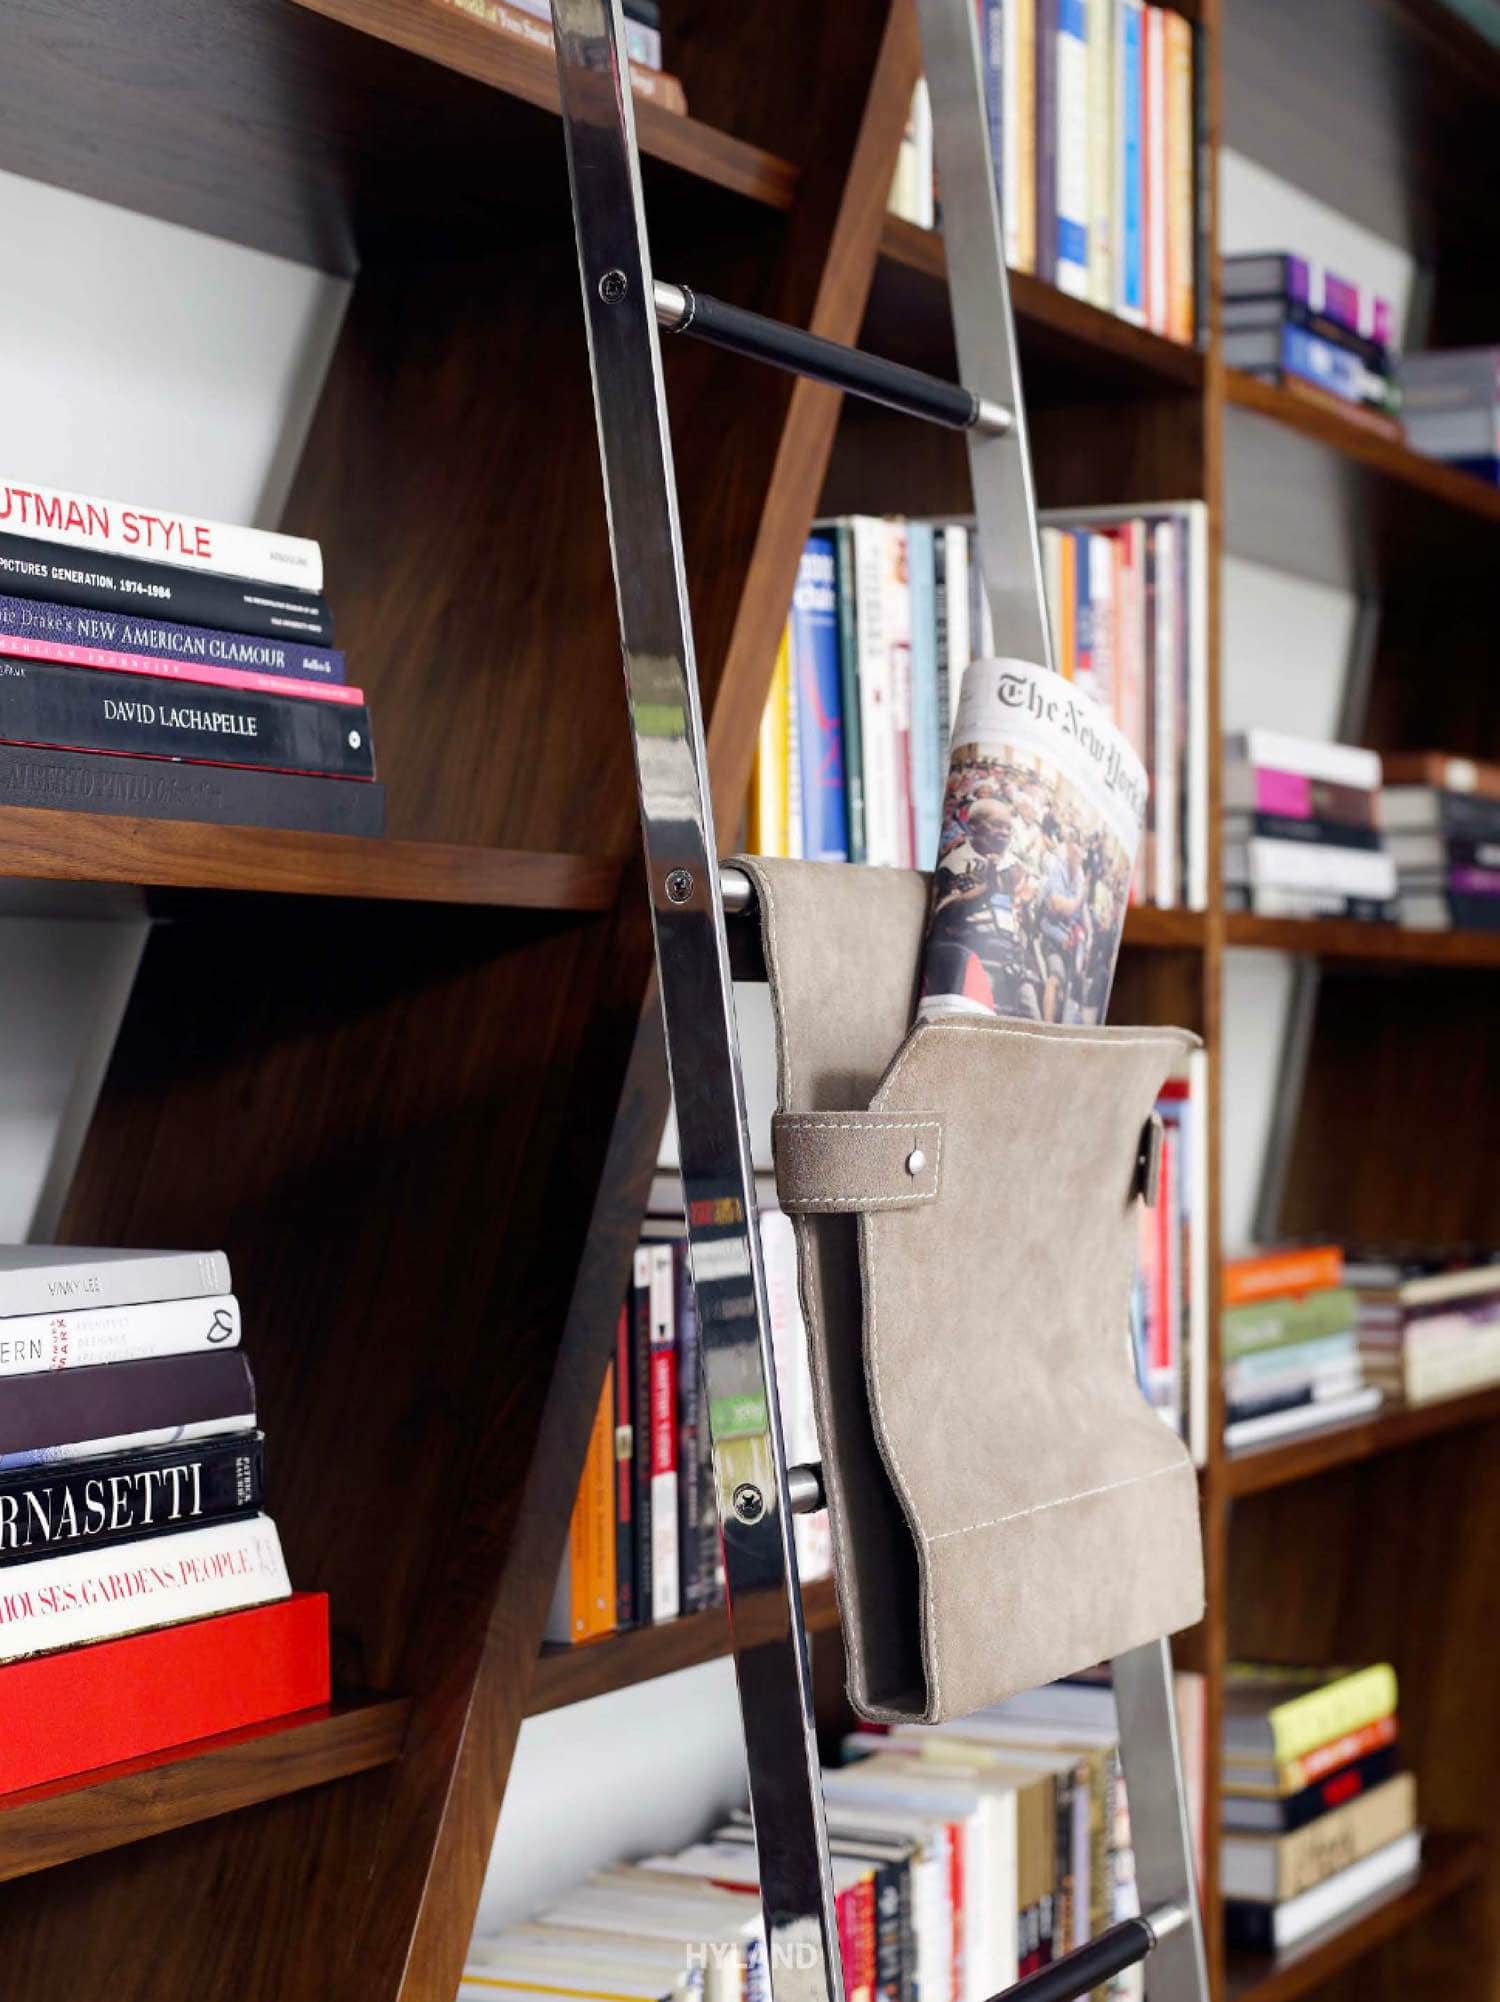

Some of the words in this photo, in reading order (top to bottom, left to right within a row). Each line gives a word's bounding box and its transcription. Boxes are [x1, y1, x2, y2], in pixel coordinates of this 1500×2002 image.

[122, 511, 212, 558] STYLE
[77, 617, 116, 641] NEW
[121, 625, 206, 657] AMERICAN
[209, 640, 286, 670] GLAMOUR
[103, 699, 156, 725] DAVID
[158, 706, 258, 736] LACHAPELLE
[997, 671, 1059, 723] The
[1061, 699, 1105, 763] New
[0, 1463, 203, 1550] RNASETTI
